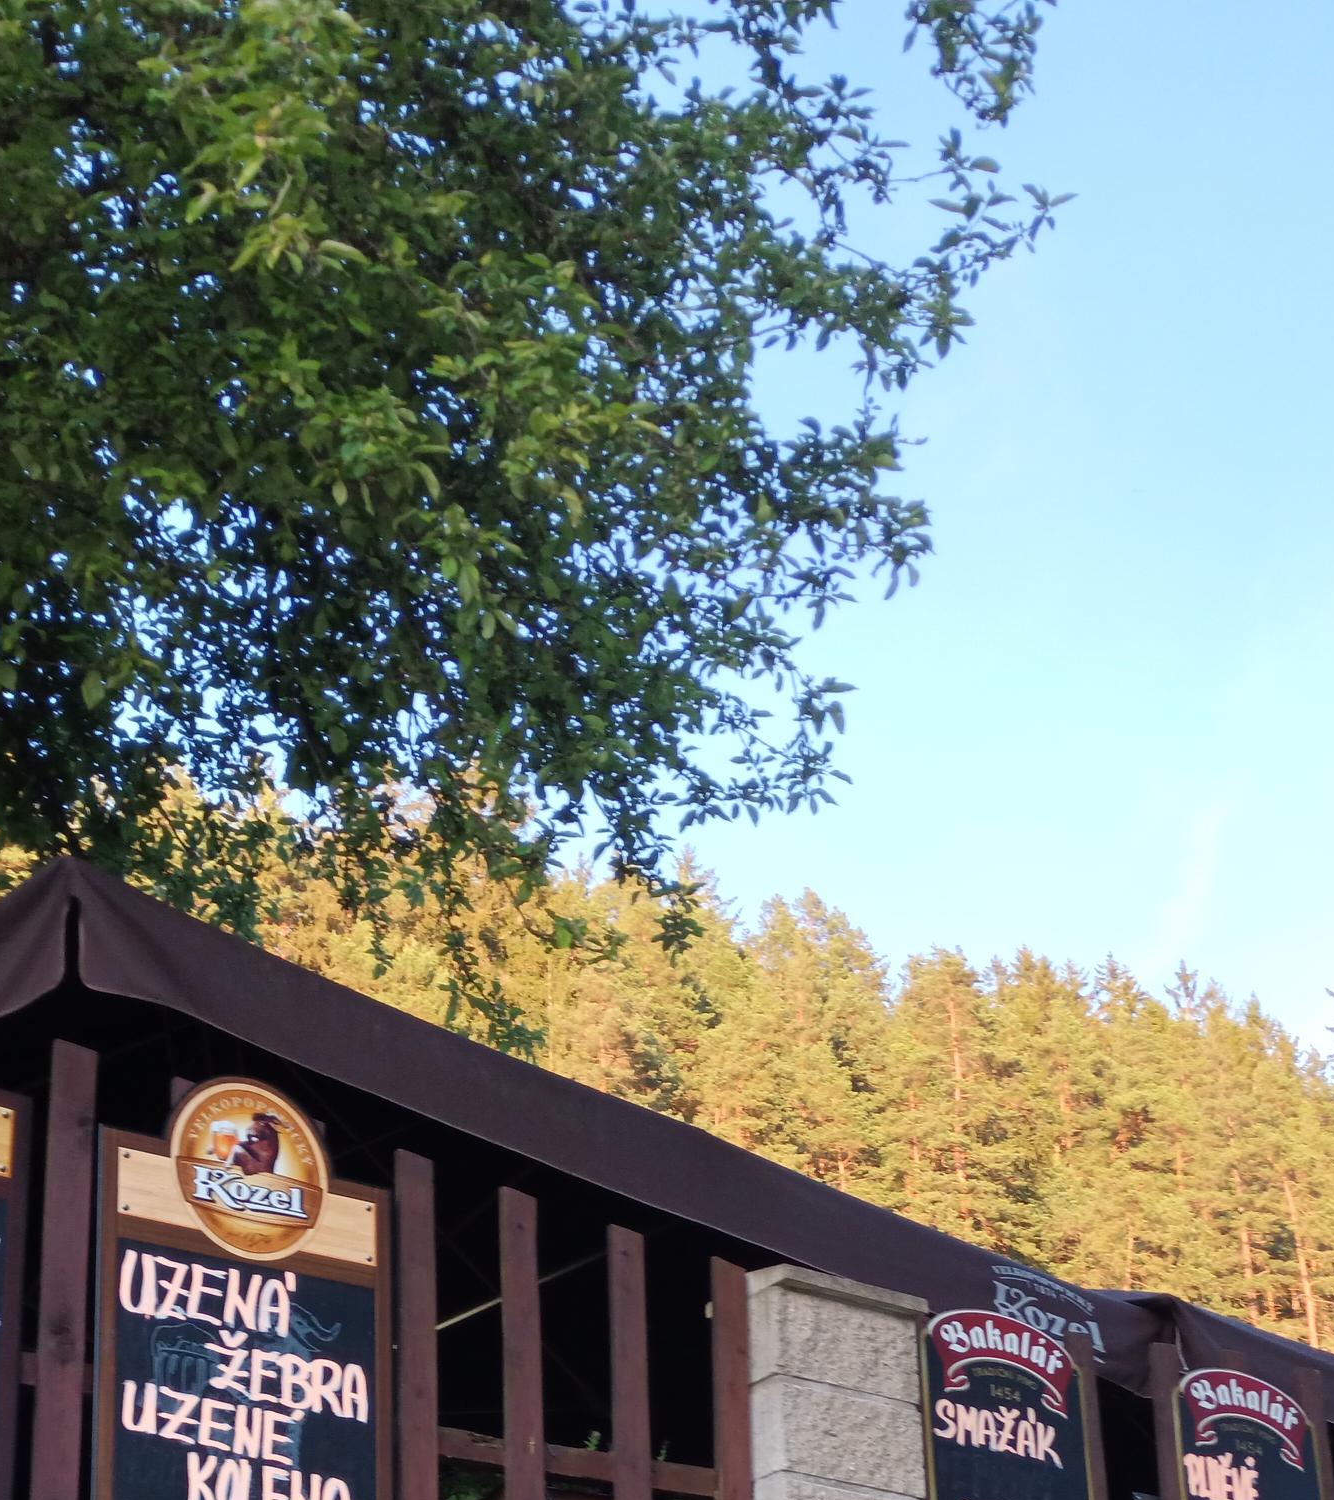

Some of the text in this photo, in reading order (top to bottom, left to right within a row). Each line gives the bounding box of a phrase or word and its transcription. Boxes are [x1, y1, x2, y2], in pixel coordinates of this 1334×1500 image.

[192, 1164, 309, 1219] Kozel
[118, 1248, 296, 1338] UZENÁ
[204, 1330, 369, 1424] ŽEBRA
[939, 1319, 1064, 1375] Bakalář
[120, 1380, 305, 1466] UZENÉ
[933, 1398, 1064, 1470] SMAŽÁK
[1190, 1378, 1299, 1430] Bakalář
